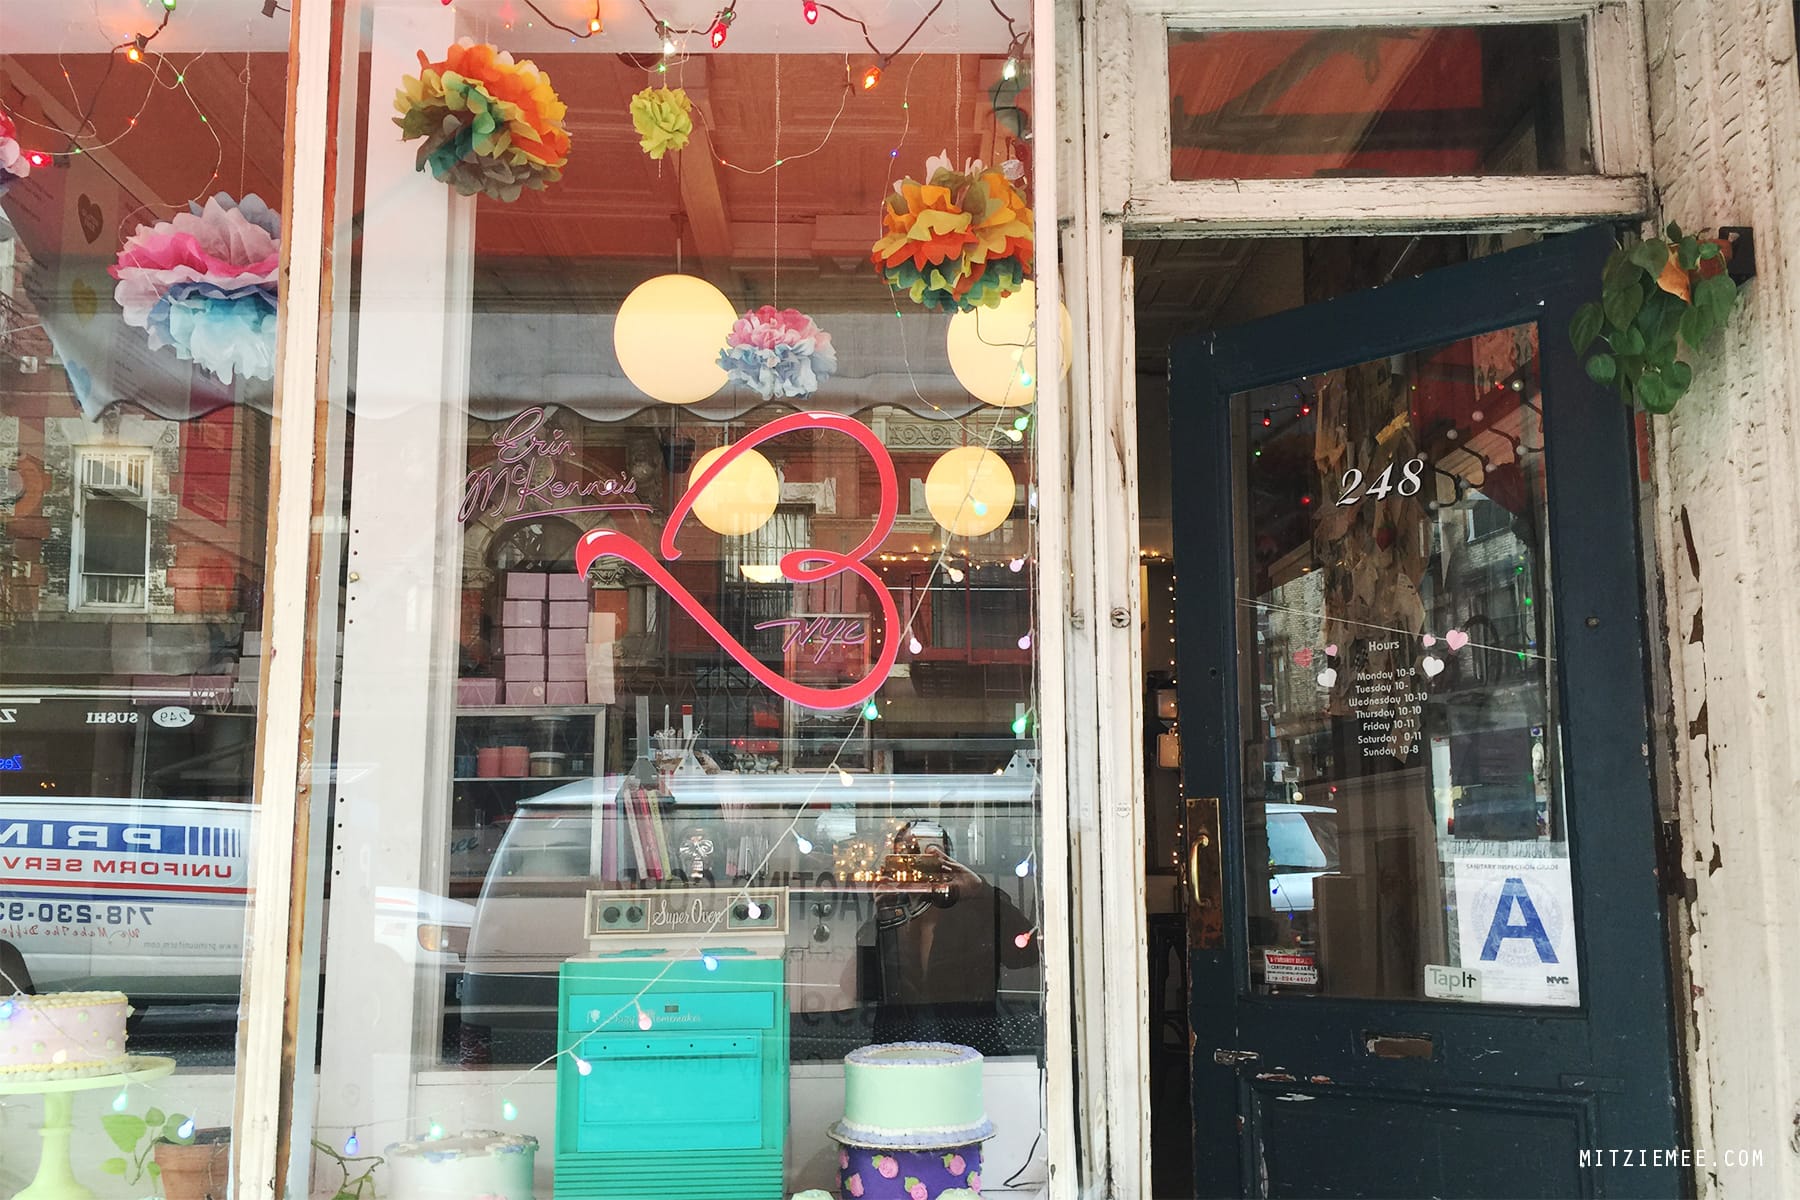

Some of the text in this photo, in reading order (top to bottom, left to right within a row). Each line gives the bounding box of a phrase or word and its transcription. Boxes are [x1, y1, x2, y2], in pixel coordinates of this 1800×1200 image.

[492, 407, 577, 464] Erin
[1336, 458, 1424, 507] 248
[754, 616, 867, 664] NYC
[1368, 640, 1400, 652] Hours
[1356, 667, 1416, 681] Monday 10-8
[1355, 684, 1392, 694] Tuesday
[1348, 692, 1428, 707] Wednesday 10-10
[1355, 706, 1422, 719] Thursday 10-10
[1363, 719, 1415, 731] Friday 10-11
[1357, 735, 1397, 745] Saturday
[1363, 745, 1419, 757] Sunday 10-8
[651, 898, 723, 930] Super Oven
[1480, 877, 1560, 964] A
[1546, 976, 1569, 985] NYC
